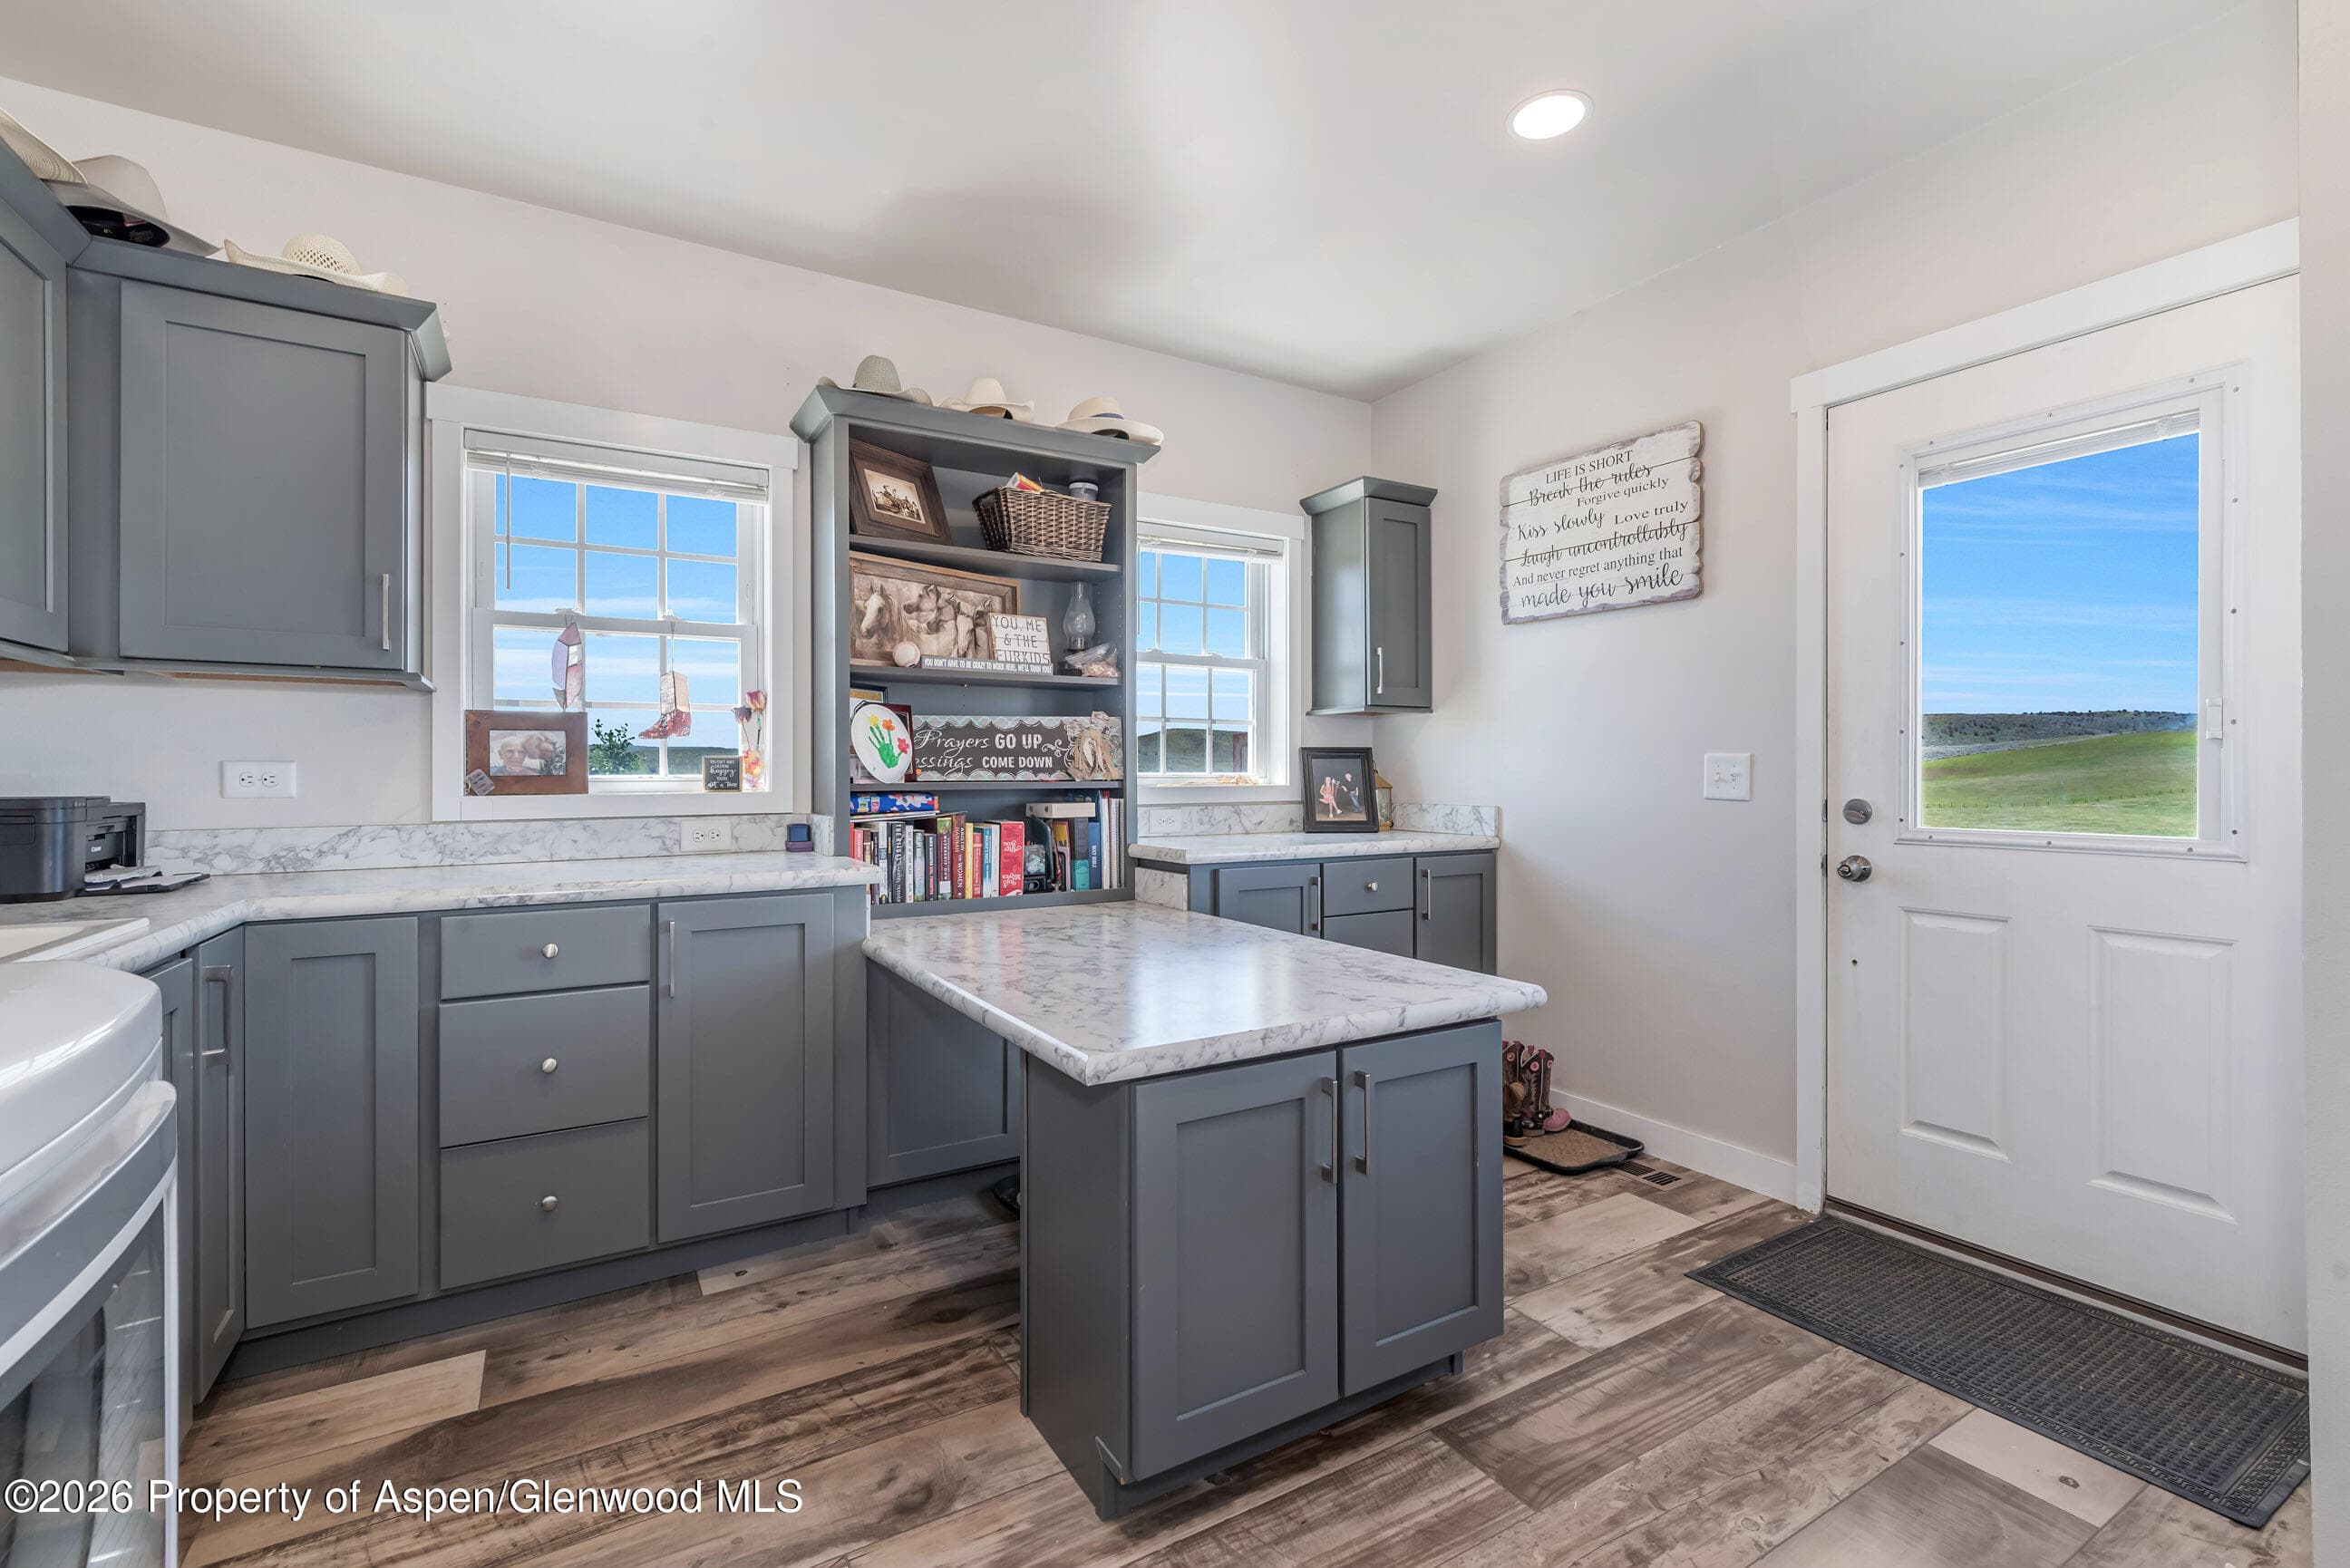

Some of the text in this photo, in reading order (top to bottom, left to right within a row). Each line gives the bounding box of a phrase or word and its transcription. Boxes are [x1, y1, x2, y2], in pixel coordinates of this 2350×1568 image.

[1546, 450, 1634, 484] LIFE IS SHORT
[1529, 463, 1651, 506] Break the rules
[1577, 478, 1669, 508] Forgive quickly
[1517, 501, 1688, 541] Kiss slowly Love truly
[1520, 518, 1688, 567] Laugh uncontrollably
[1513, 546, 1684, 587] And never regret anything that
[1521, 562, 1684, 608] made you smile
[993, 615, 1043, 633] YOU, ME
[1005, 634, 1037, 648] & THE
[924, 658, 934, 666] YOU
[934, 658, 947, 667] DON'T
[947, 659, 958, 668] HAVE
[959, 660, 966, 668] TO
[966, 661, 972, 669] BE
[972, 661, 986, 670] CRAZY
[986, 662, 992, 670] TO
[992, 662, 1004, 670] WORK
[996, 649, 1050, 664] FURKIDS
[913, 729, 1043, 759] Prayers GO UP
[915, 756, 1053, 780] essings COME DOWN
